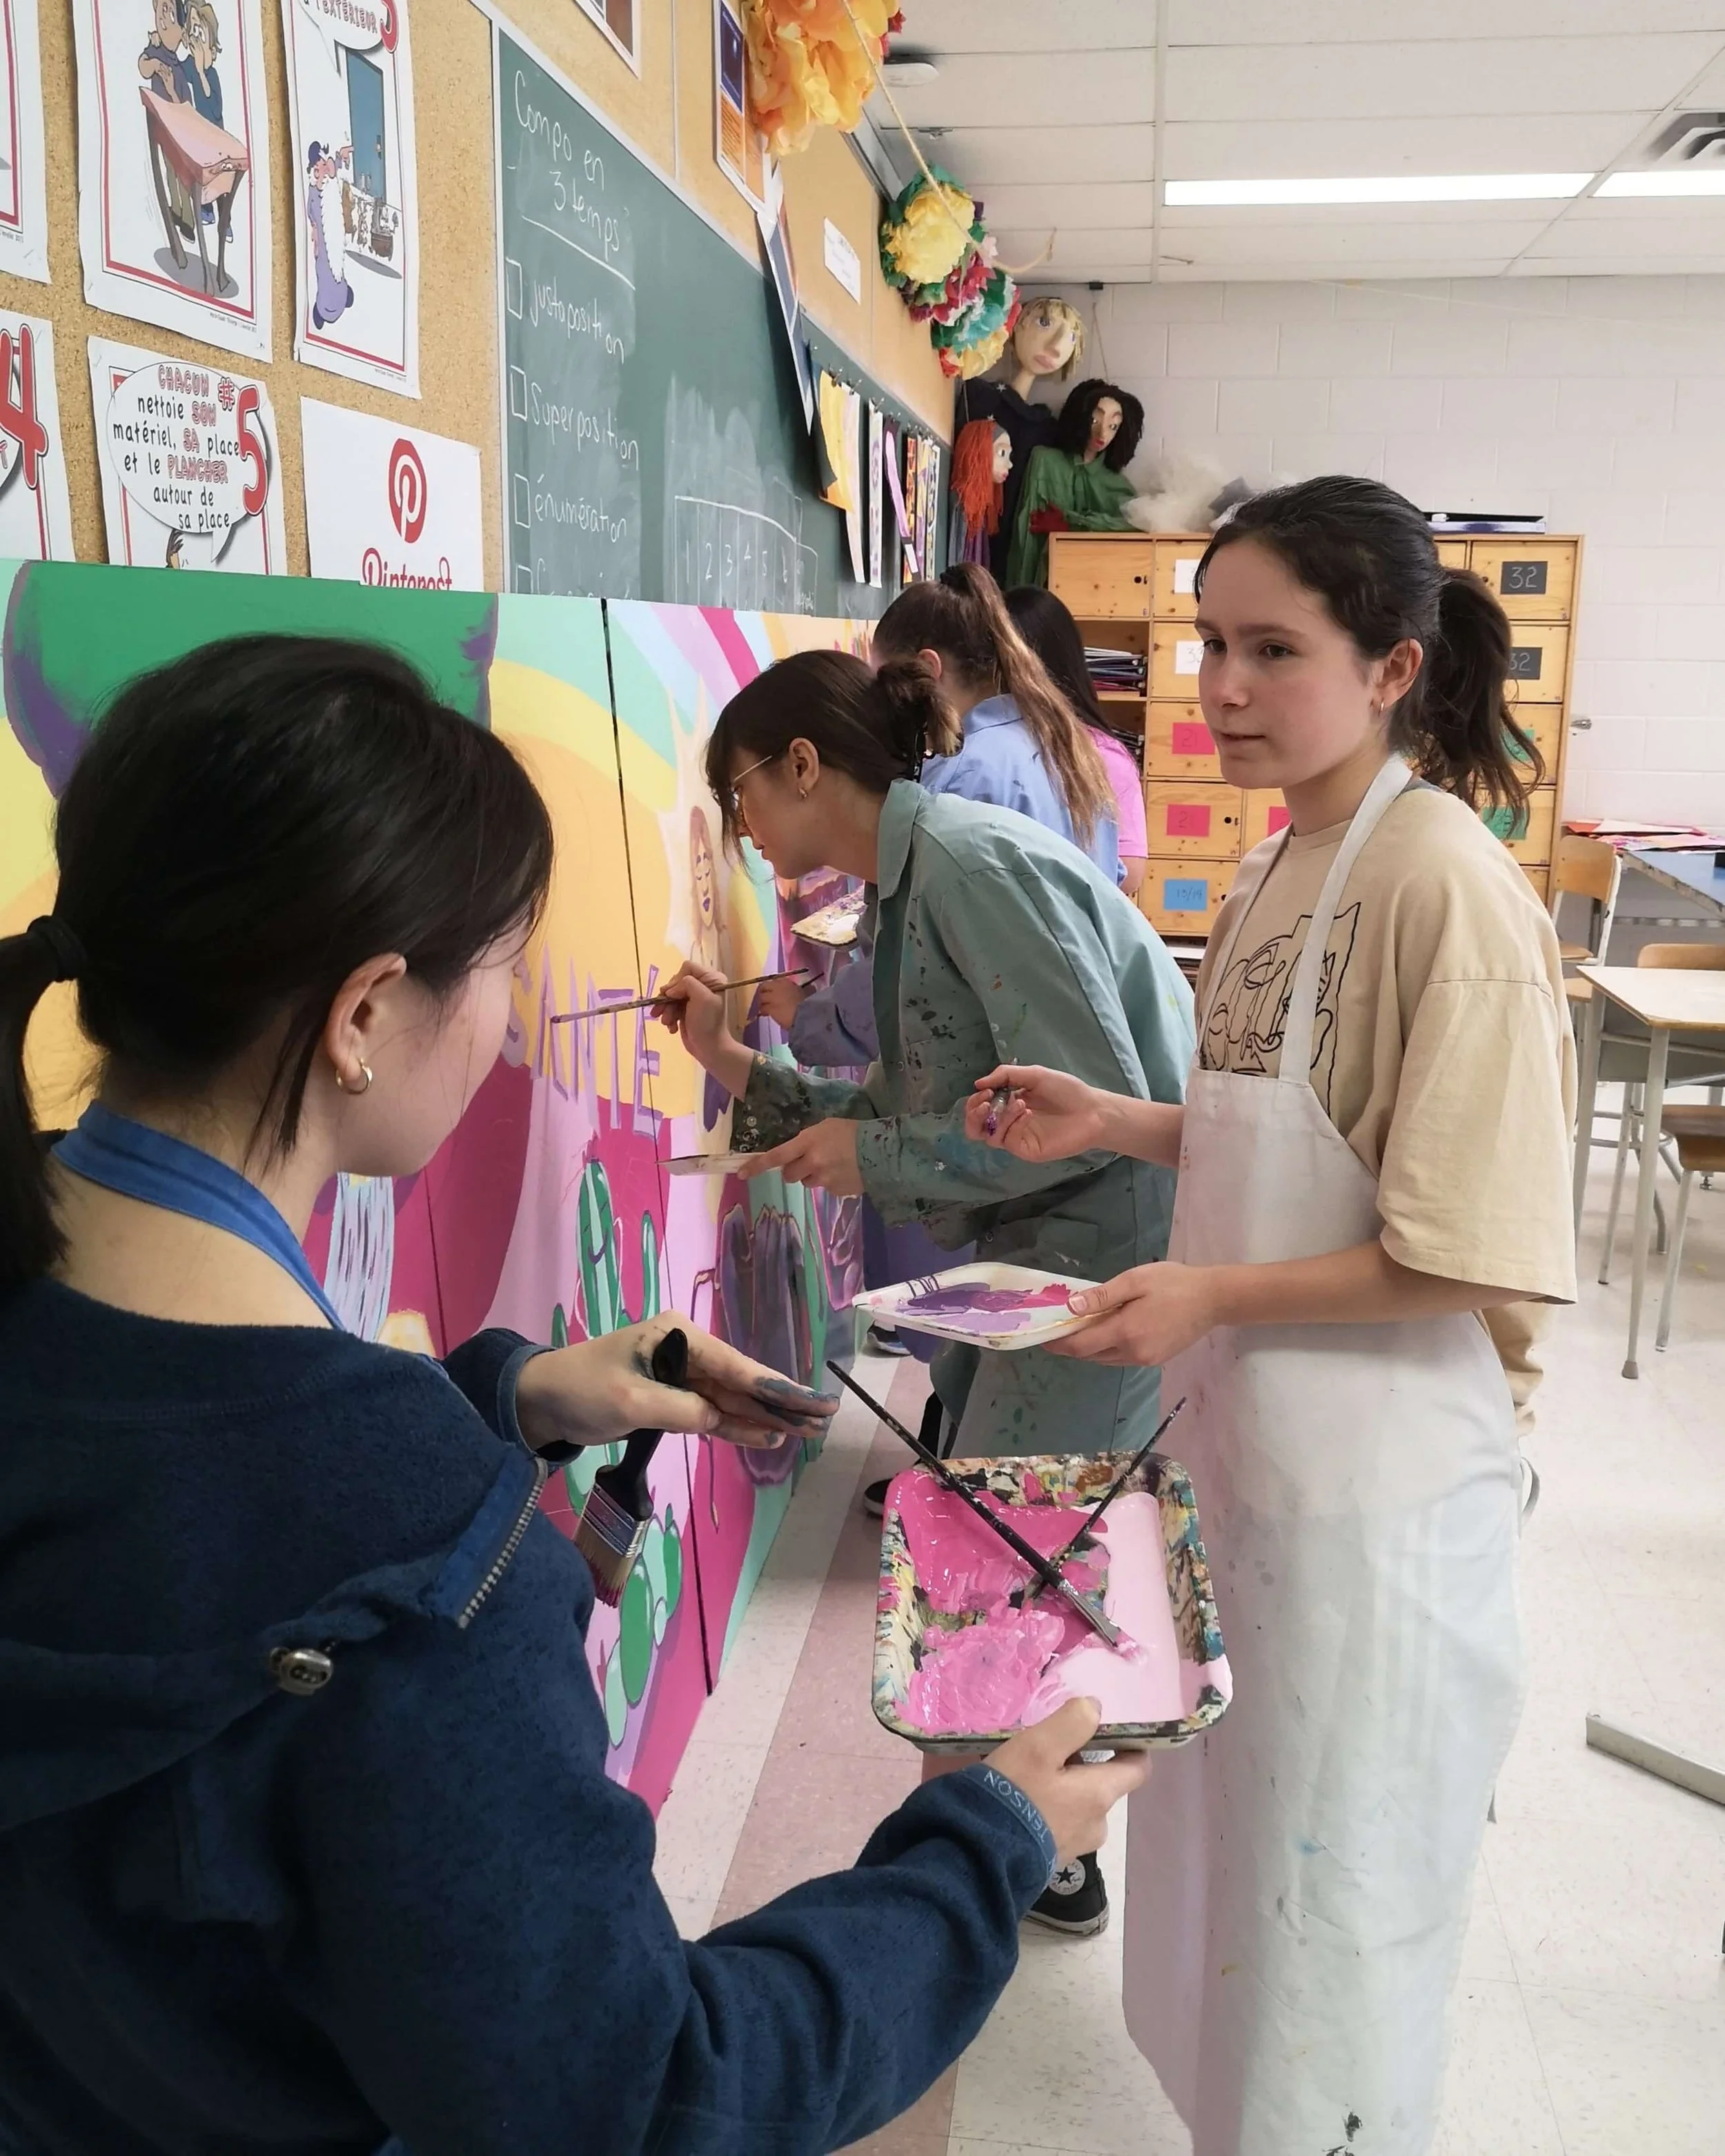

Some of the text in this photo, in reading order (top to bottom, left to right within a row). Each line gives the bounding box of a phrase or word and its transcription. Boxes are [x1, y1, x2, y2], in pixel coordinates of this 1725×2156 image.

[515, 70, 604, 190] Compo en
[549, 171, 620, 261] 3 temps
[157, 364, 210, 397] CHACUN
[137, 394, 217, 427] nettoie SON
[112, 420, 239, 457] matériel, SA place
[124, 452, 229, 484] et le PLANCHER
[153, 484, 214, 507] autour de
[179, 508, 230, 533] sa place
[724, 544, 733, 577] 3
[1508, 565, 1538, 590] 32
[1509, 651, 1531, 672] 32
